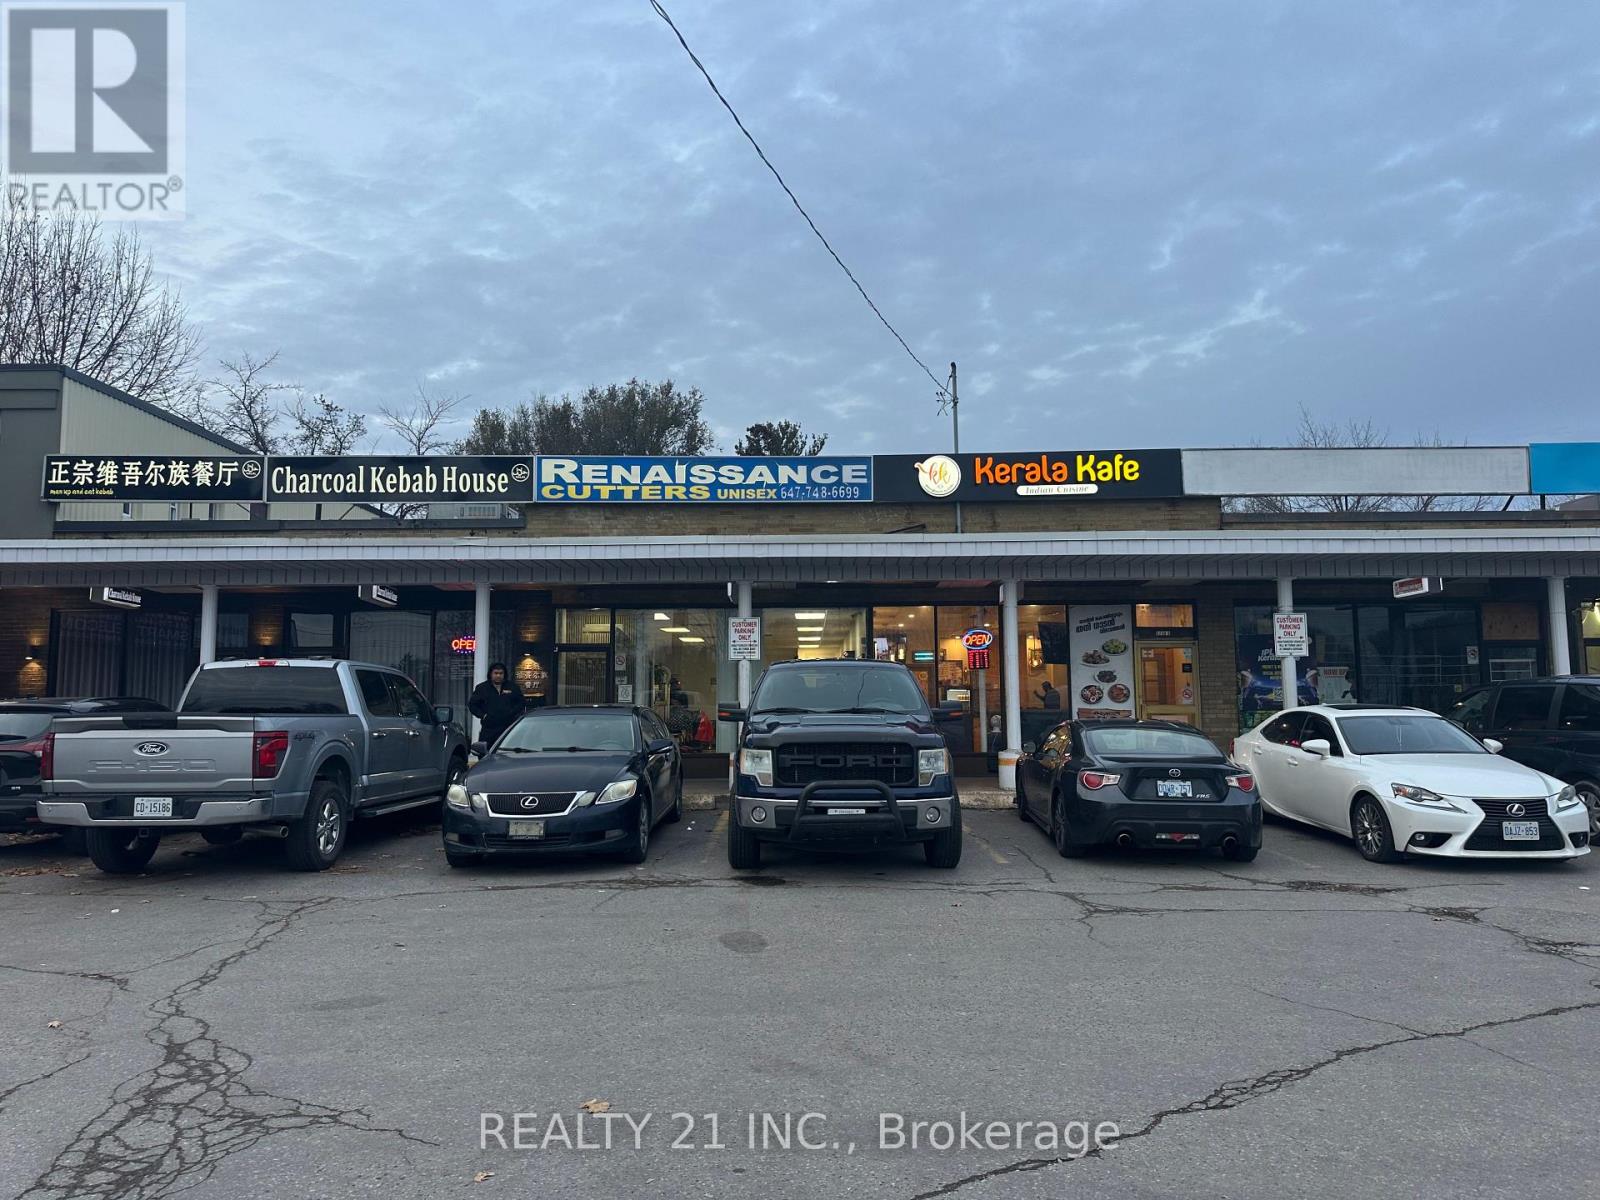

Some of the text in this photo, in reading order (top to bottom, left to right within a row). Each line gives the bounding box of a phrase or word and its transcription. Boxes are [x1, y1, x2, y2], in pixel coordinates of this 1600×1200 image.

[48, 460, 239, 487] 正宗维吾尔族餐厅
[974, 453, 1140, 484] Kerala Kafe
[271, 465, 509, 493] Charcoal Kebab House
[541, 485, 860, 500] CUTTERS UNISEX 647-748-6699
[1025, 485, 1089, 495] Indian Cuisine
[965, 634, 990, 646] OPEN
[142, 743, 162, 753] Ford
[87, 759, 217, 774] F-150
[779, 754, 913, 767] FORD
